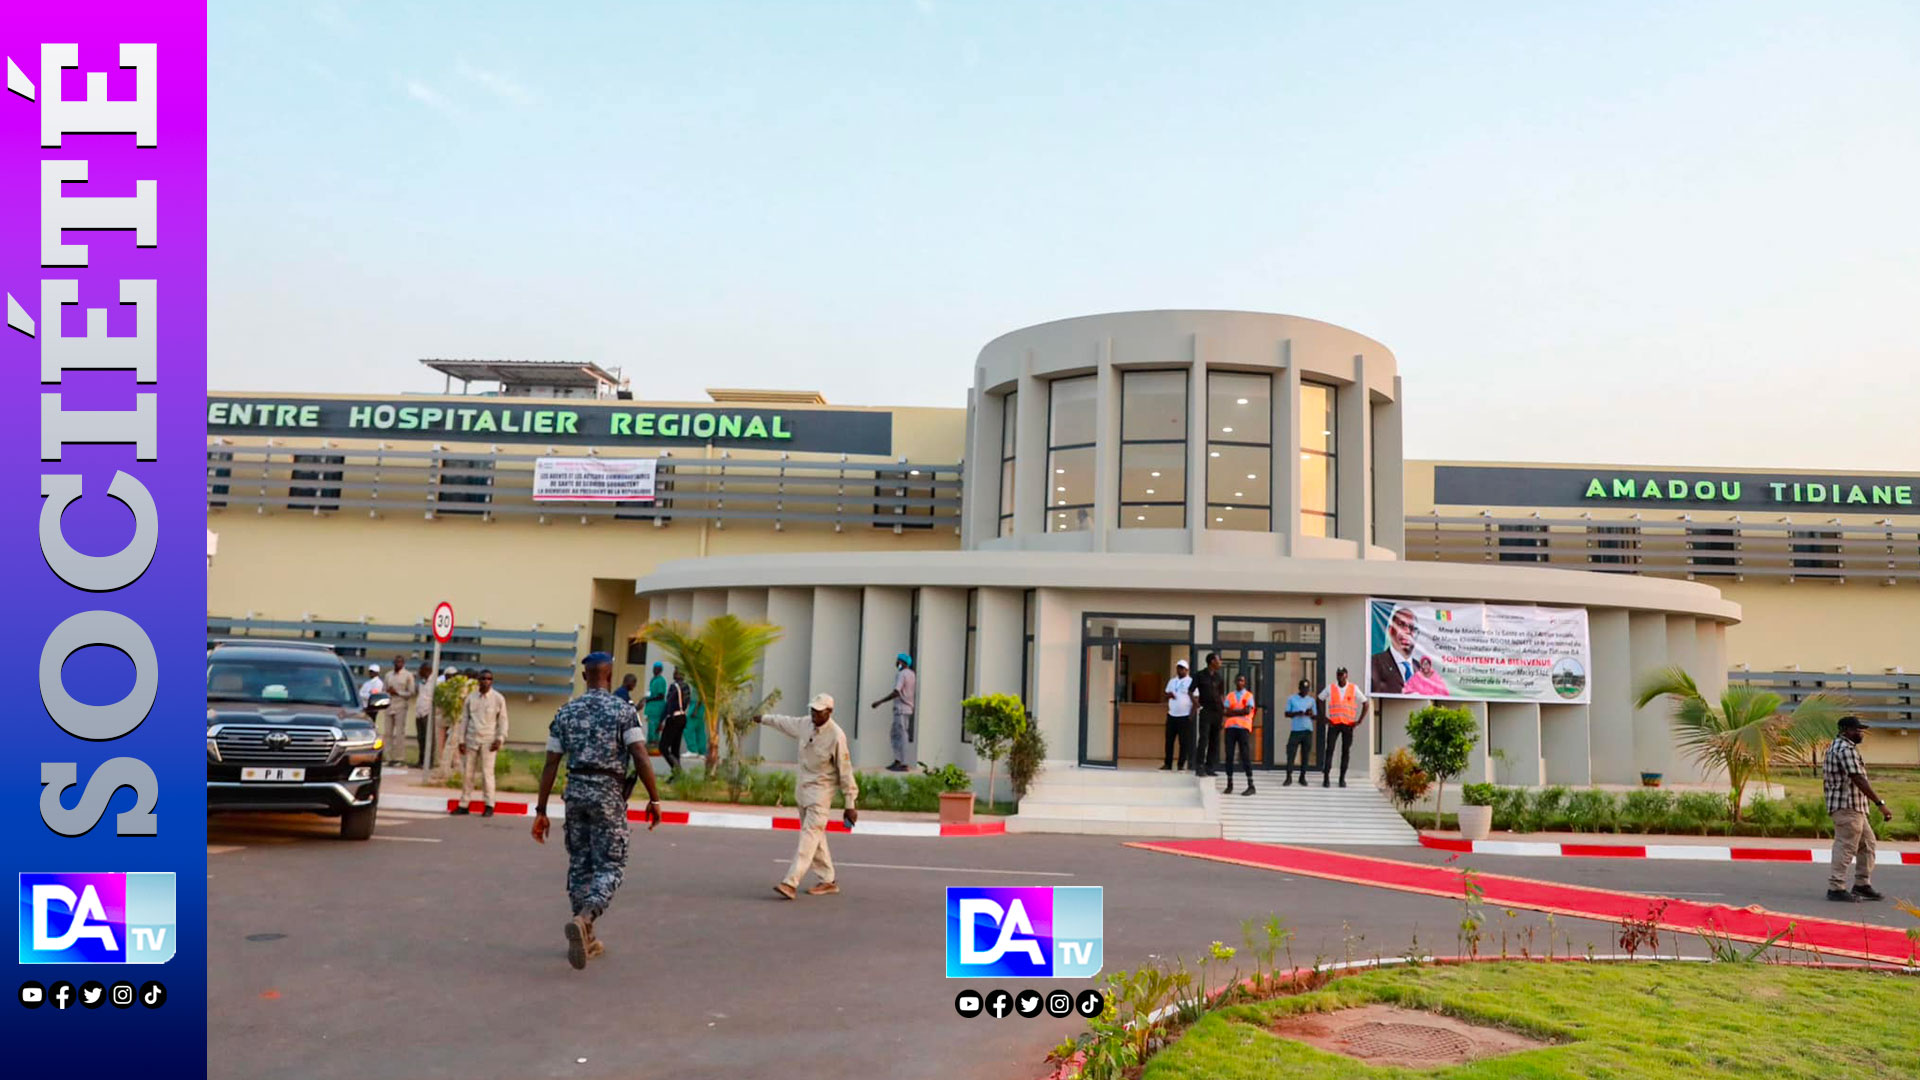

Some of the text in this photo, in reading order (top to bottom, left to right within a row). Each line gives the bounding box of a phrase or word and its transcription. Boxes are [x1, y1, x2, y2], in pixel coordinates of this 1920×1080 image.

[348, 406, 579, 435] HOSPITALIER
[610, 412, 793, 440] REGIONAL
[1585, 477, 1914, 505] AMADOU TIDIANE
[437, 614, 450, 628] 30
[1441, 656, 1495, 665] SOUHAITENT
